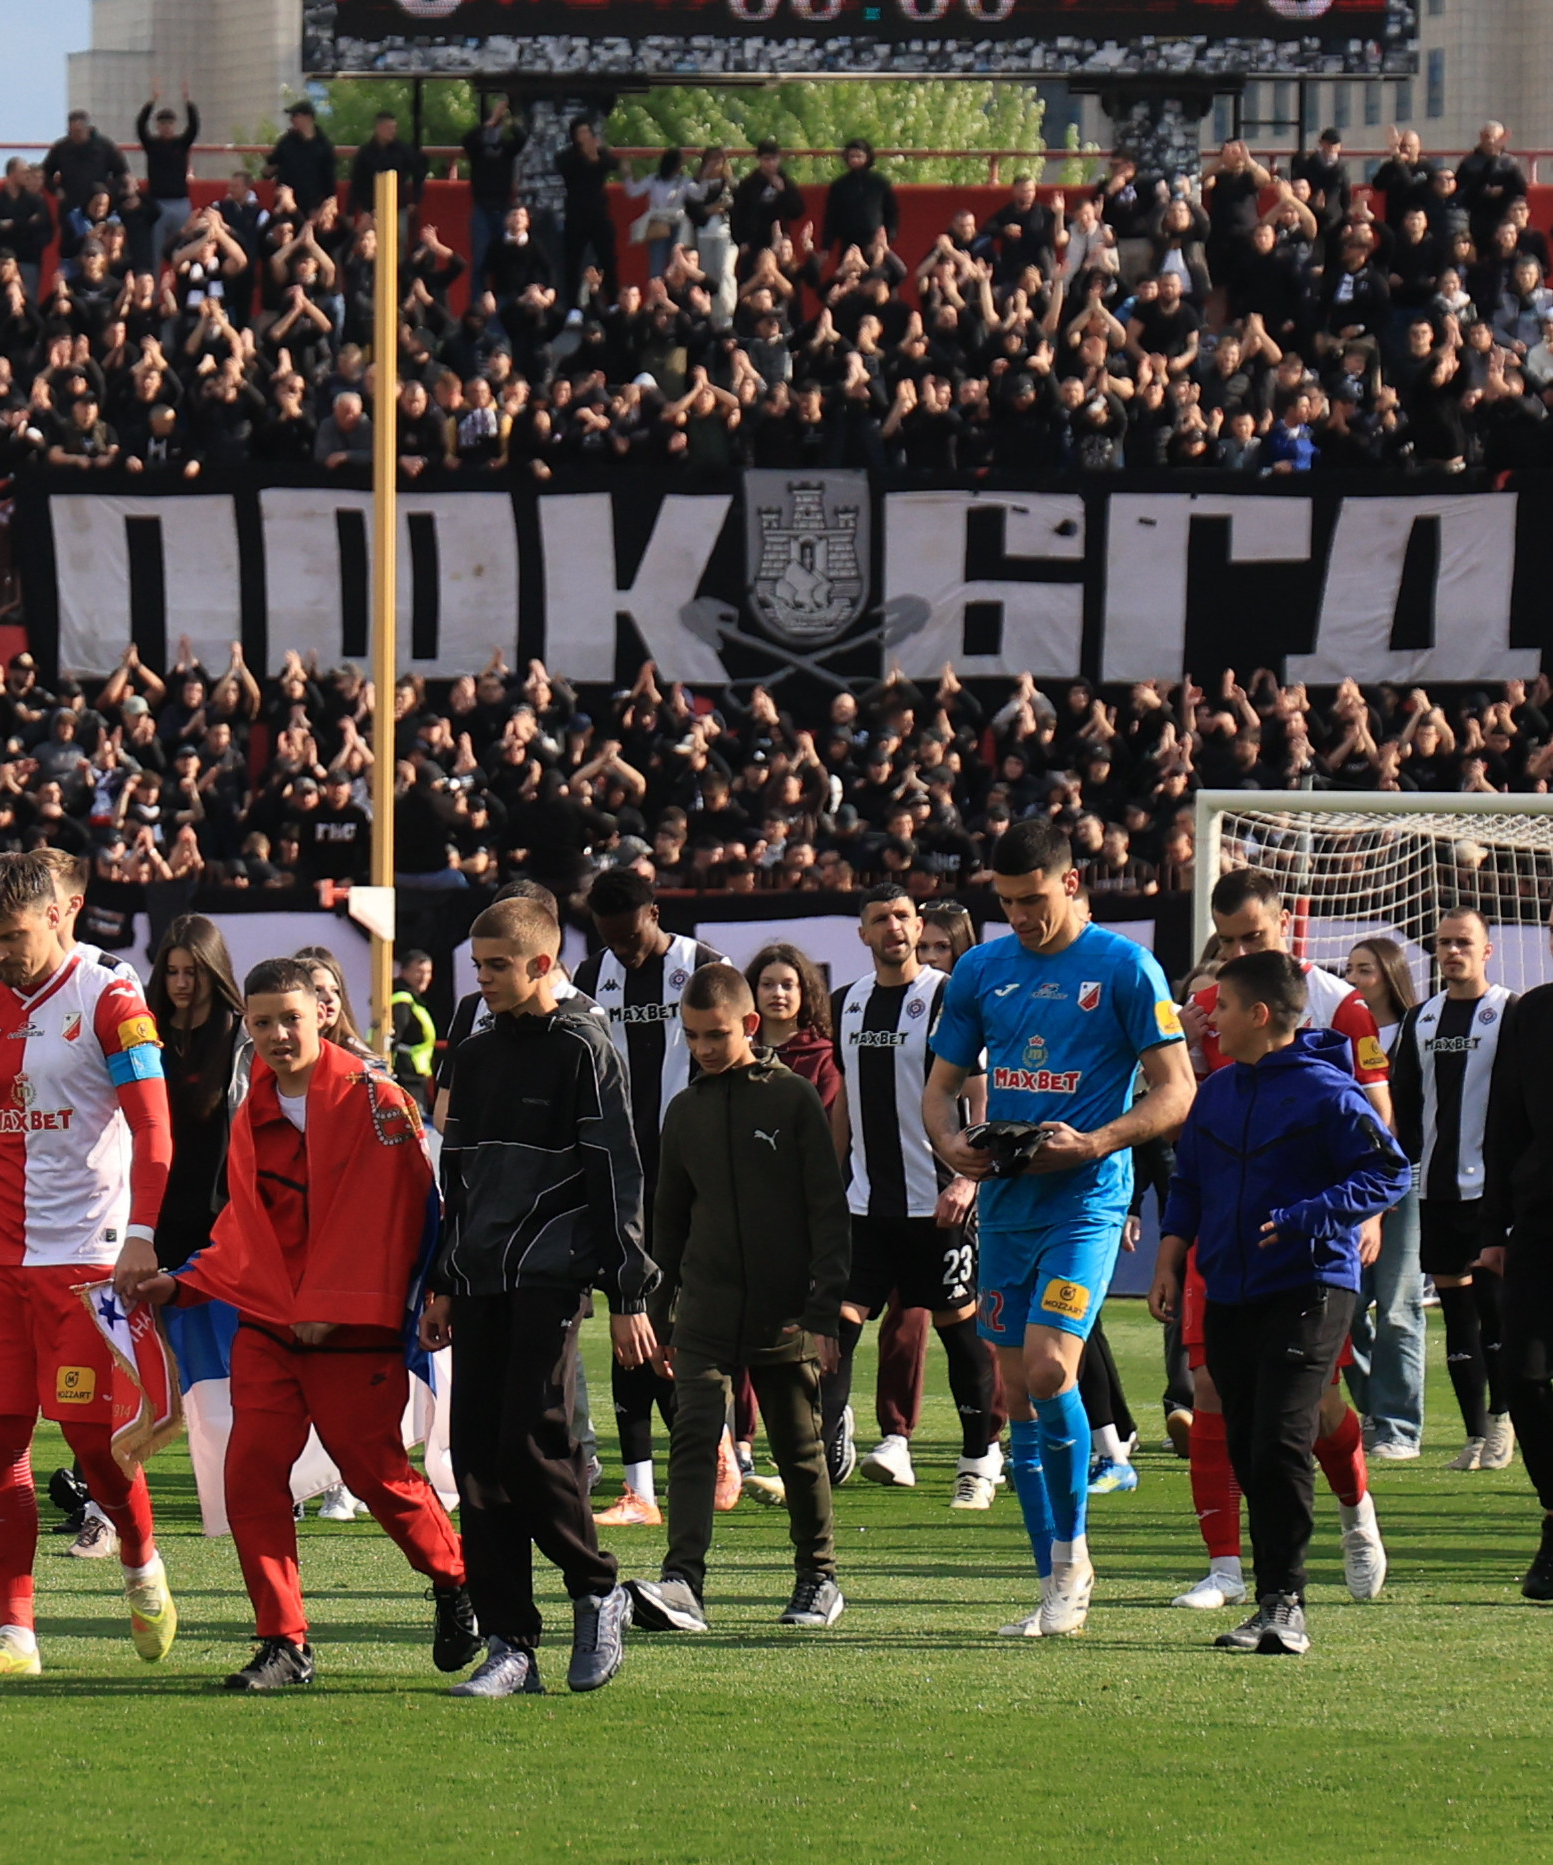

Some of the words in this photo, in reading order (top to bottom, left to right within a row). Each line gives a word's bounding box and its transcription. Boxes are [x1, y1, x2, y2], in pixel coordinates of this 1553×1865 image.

[883, 490, 1542, 684] БГД
[608, 1002, 679, 1022] MAXBET
[848, 1031, 909, 1047] MAXBET
[1423, 1037, 1481, 1052] MAXBET
[994, 1067, 1082, 1094] MAXBET
[943, 1245, 973, 1285] 23
[113, 1404, 132, 1418] 914
